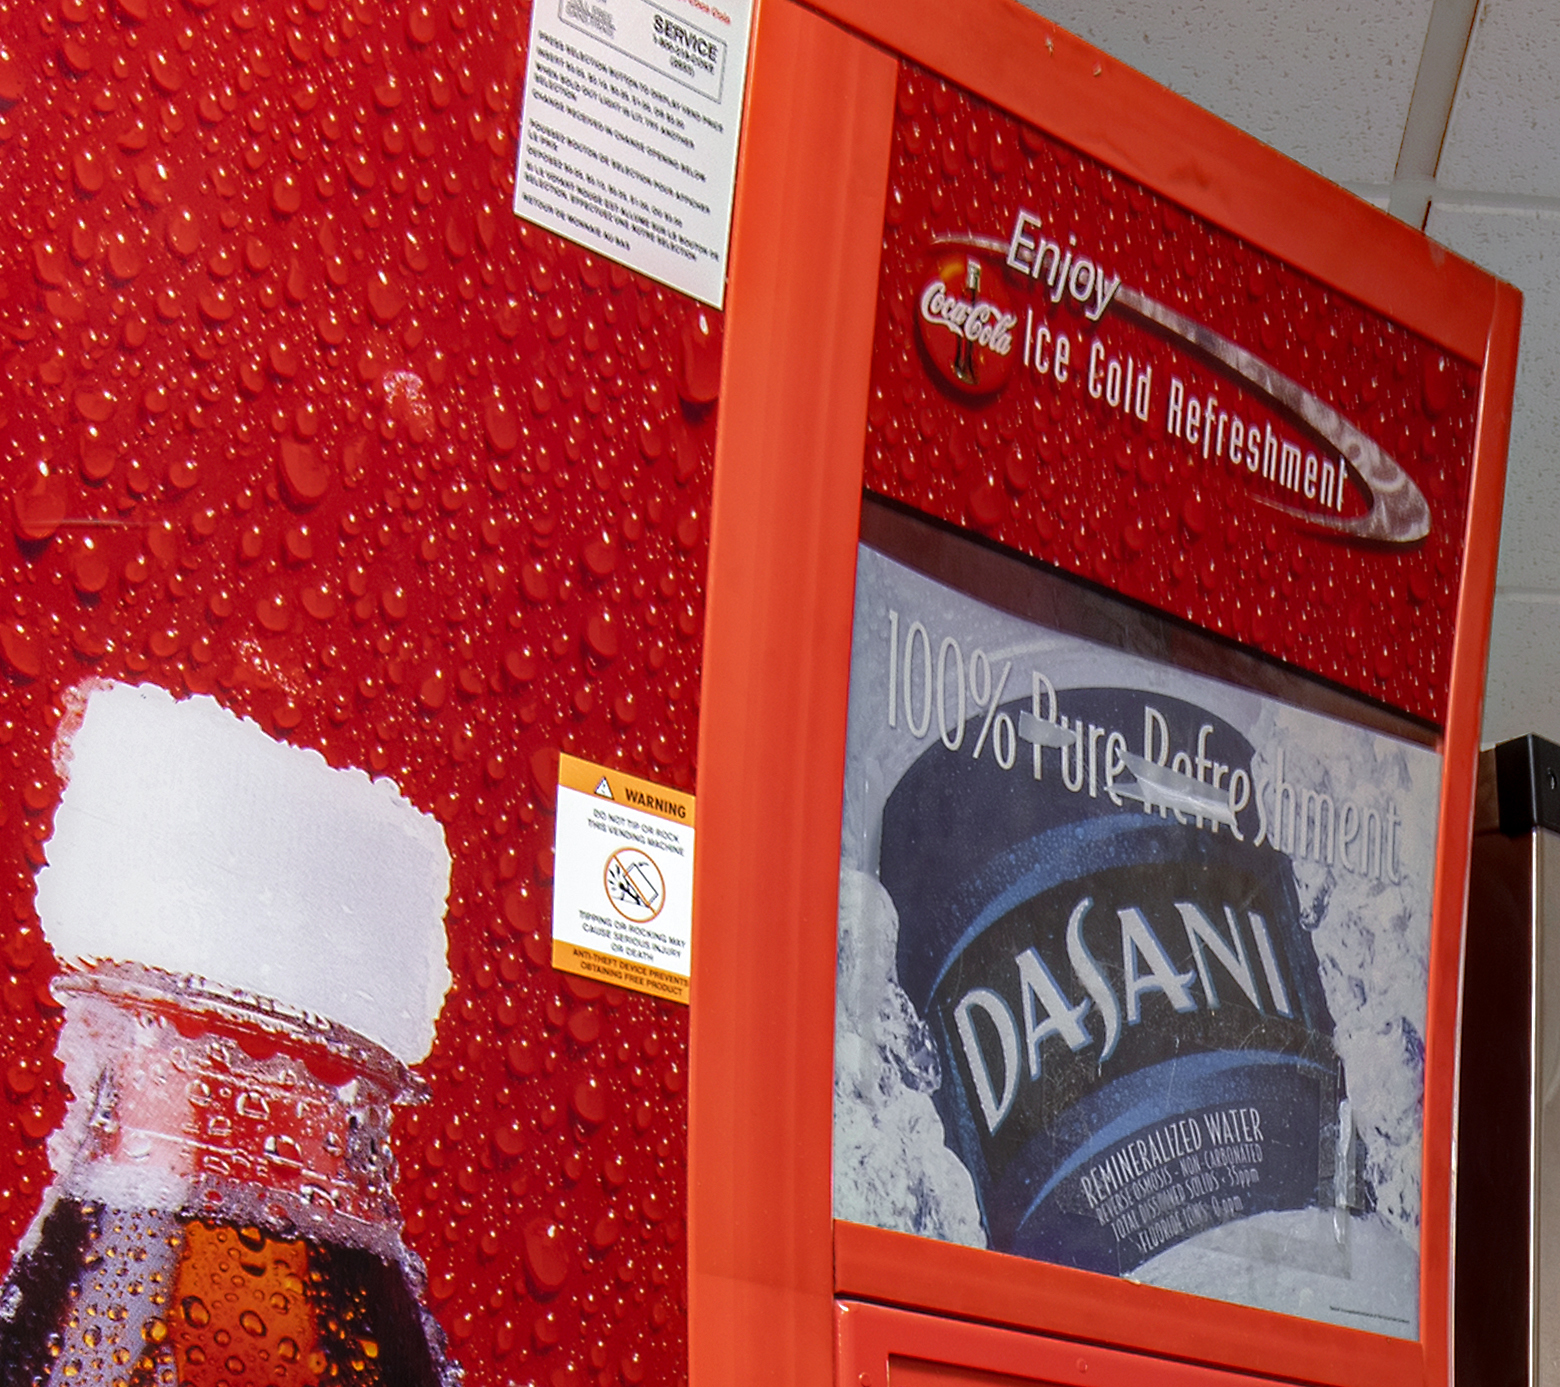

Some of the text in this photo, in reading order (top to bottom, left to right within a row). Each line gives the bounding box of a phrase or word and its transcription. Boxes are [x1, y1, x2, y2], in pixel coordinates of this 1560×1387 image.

[653, 14, 718, 63] SERVICE
[1007, 210, 1120, 320] Enjoy
[921, 281, 1017, 356] Coca-Cola
[1023, 307, 1348, 513] Ice Cold Refreshment
[888, 611, 1016, 770] 100%
[1031, 671, 1128, 807] Pure
[624, 787, 686, 819] WARNING
[587, 818, 684, 856] THIS VENDING MACHINE
[593, 808, 679, 843] DO NOT TIP OR ROCK
[578, 909, 685, 948] TIPPING OR ROCKING MAY
[582, 922, 681, 958] CAUSE SERIOUS INJURY
[573, 948, 688, 987] ANTI-THEFT DEVICE PREVENTS
[610, 942, 653, 962] OR DEATH
[580, 961, 682, 996] OBTAINING FREE PRODUCT
[955, 897, 1293, 1137] DASANI
[1081, 1106, 1262, 1209] REMINERALIZED WATER
[1096, 1143, 1261, 1226] REVERSE OSMOSIS NON-CARBONATED
[1111, 1209, 1139, 1242] TOTAL
[1138, 1183, 1185, 1223] DISSED
[1186, 1170, 1218, 1199] SOLIDS
[1137, 1211, 1182, 1251] FLUORIDE
